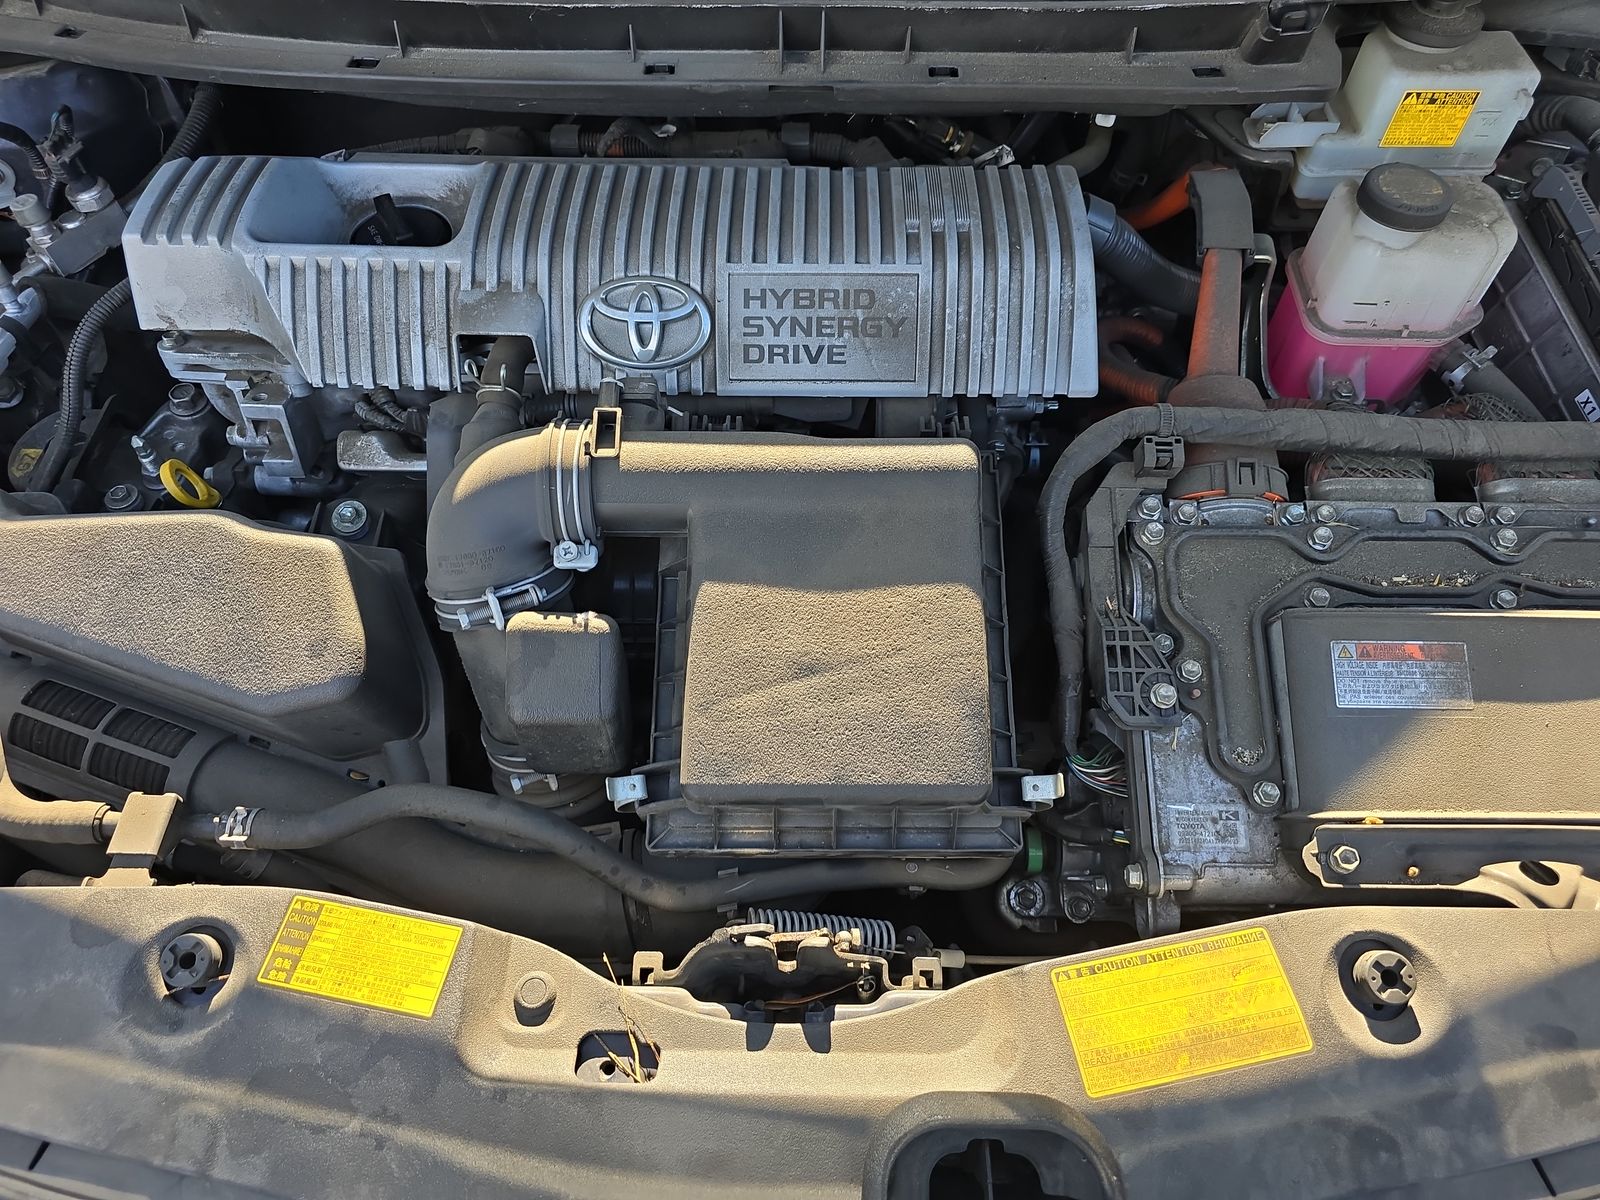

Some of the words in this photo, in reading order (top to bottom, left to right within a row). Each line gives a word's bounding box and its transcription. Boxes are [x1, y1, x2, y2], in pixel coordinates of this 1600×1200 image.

[743, 288, 876, 310] HYBRID
[743, 316, 908, 338] SYNERGY
[743, 344, 847, 364] DRIVE
[1580, 396, 1597, 416] X1
[1372, 644, 1406, 652] WARNING
[289, 912, 317, 926] CAUTION
[282, 928, 311, 940] ATTENTION
[1094, 956, 1142, 974] CAUTION
[1146, 943, 1204, 964] ATTENTION
[1208, 931, 1264, 951] ВНИМАНИЕ
[1084, 1056, 1112, 1067] READY
